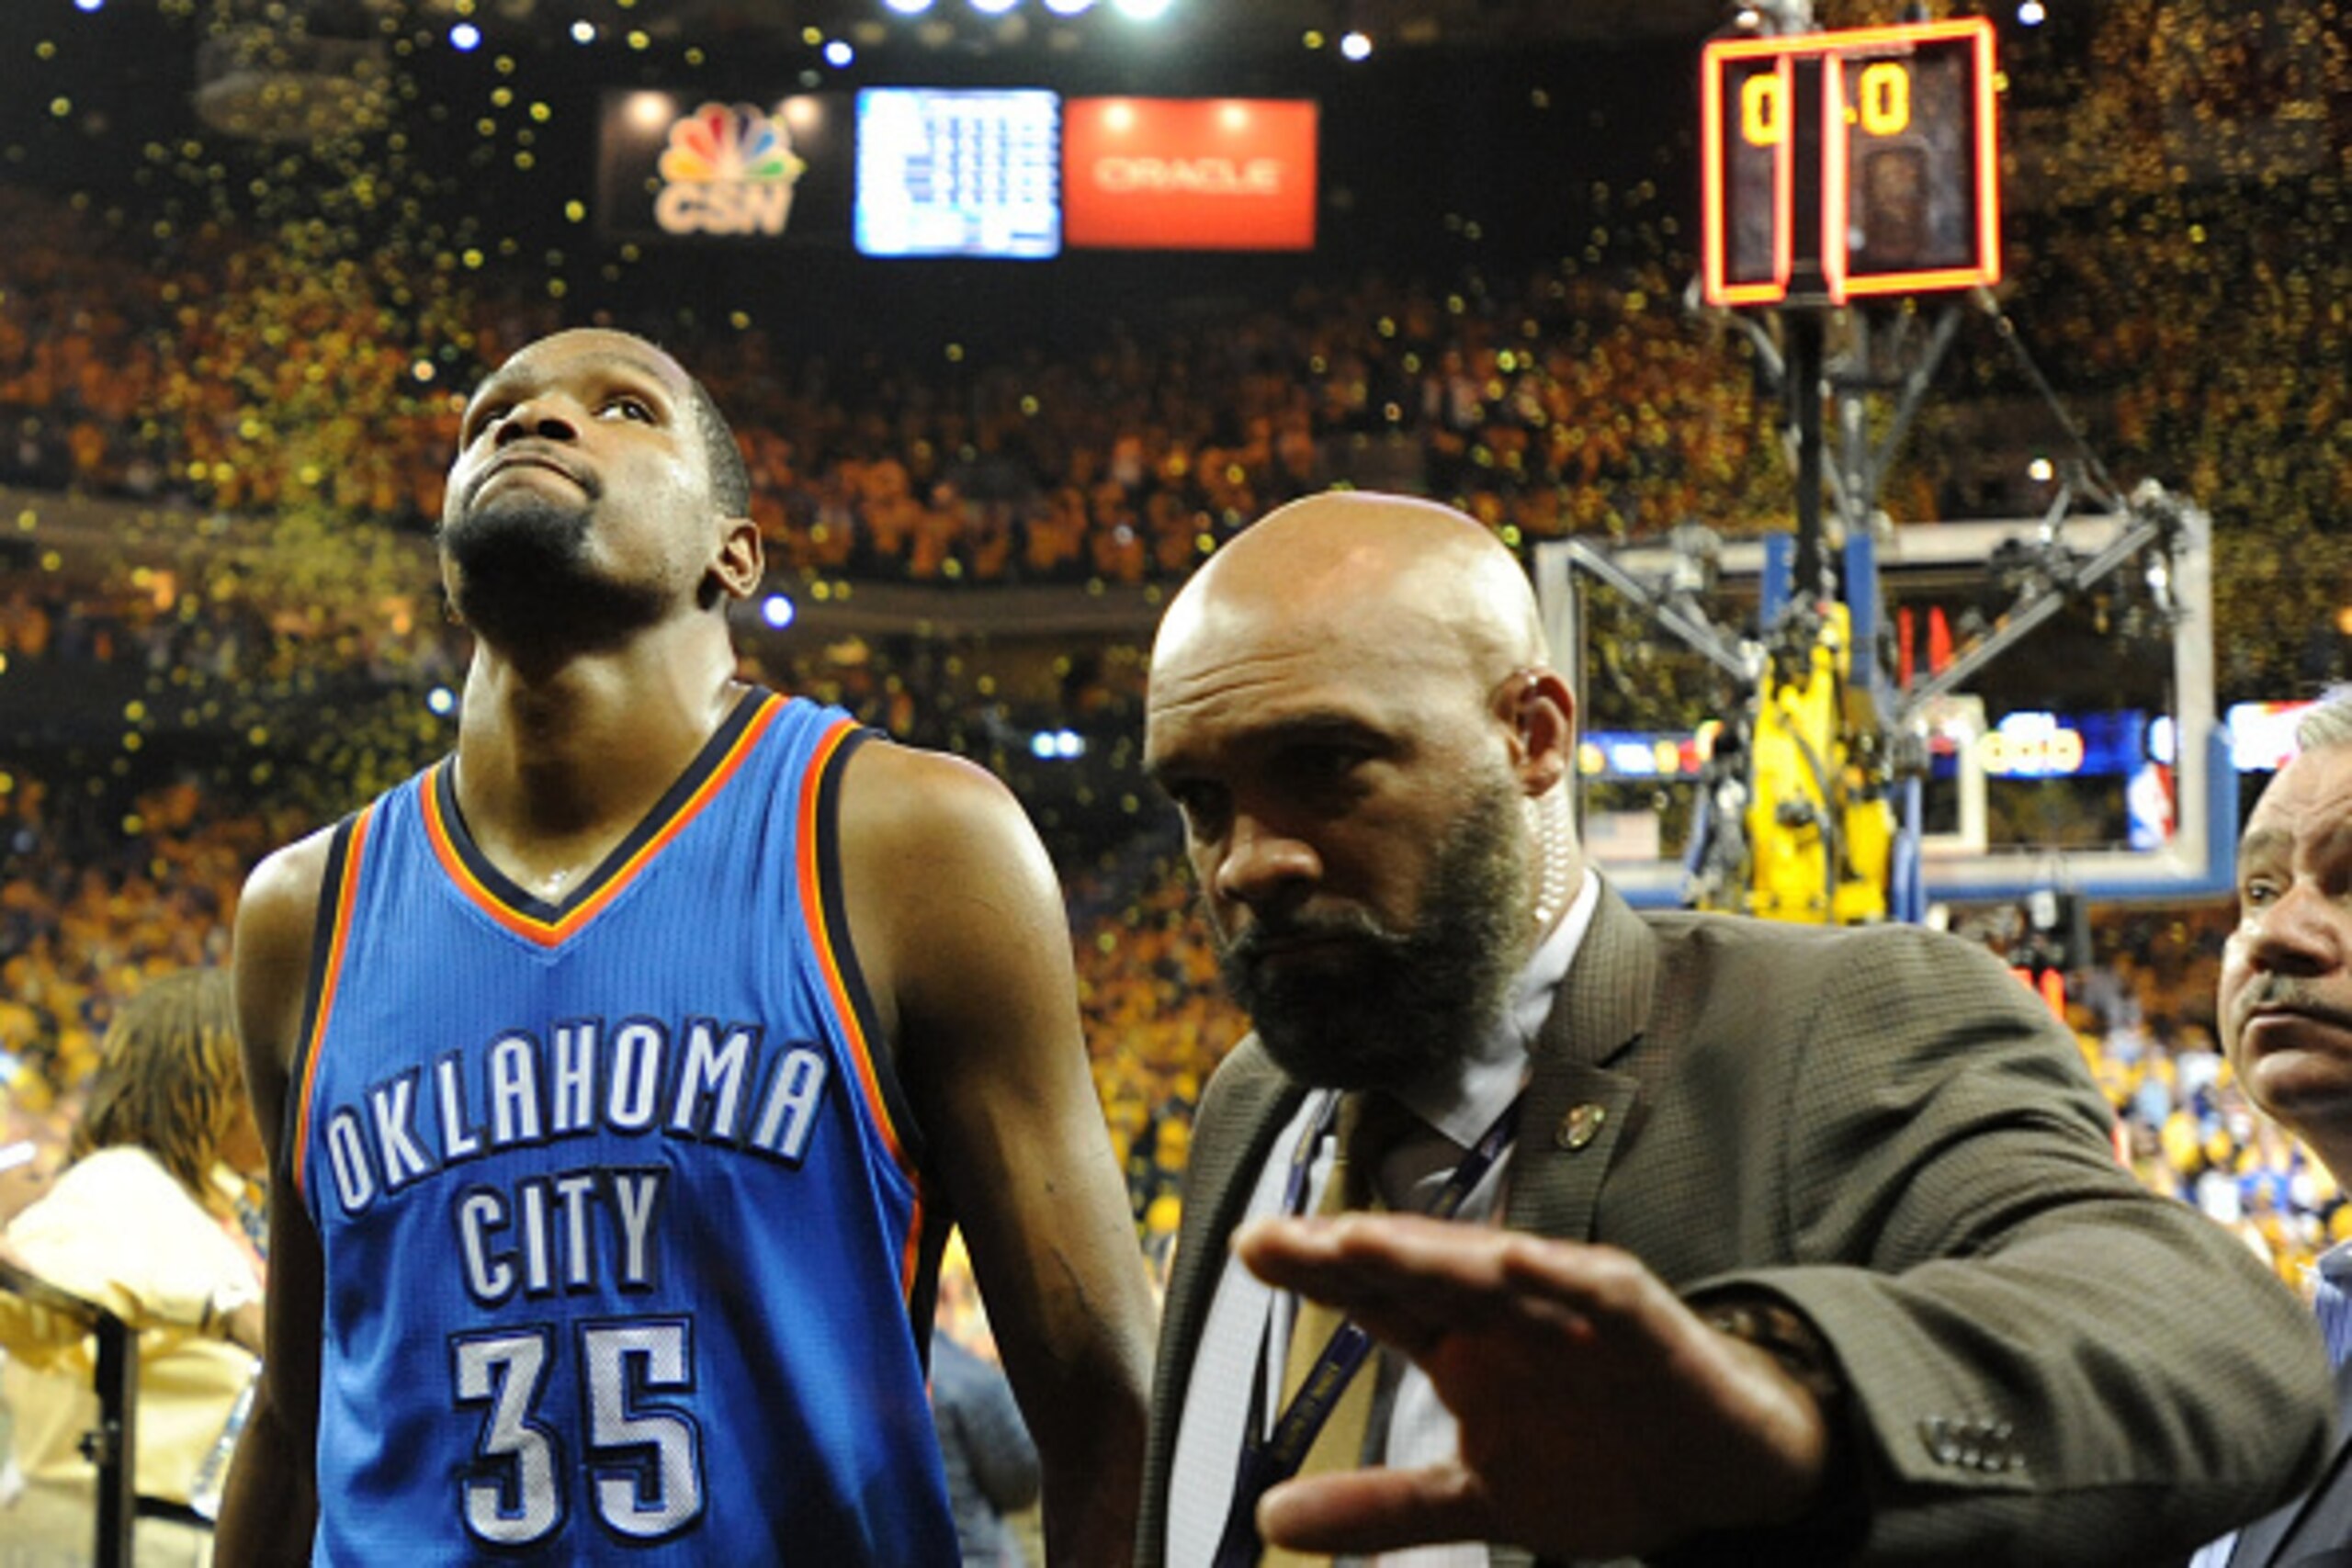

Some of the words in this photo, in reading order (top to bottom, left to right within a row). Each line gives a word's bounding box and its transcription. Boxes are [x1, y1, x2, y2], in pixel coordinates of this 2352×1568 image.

[654, 182, 794, 235] CSN
[1093, 157, 1281, 195] ORACLE
[323, 1019, 828, 1217] OKLAHOMA
[458, 1165, 668, 1305] CITY
[451, 1314, 707, 1547] 35
